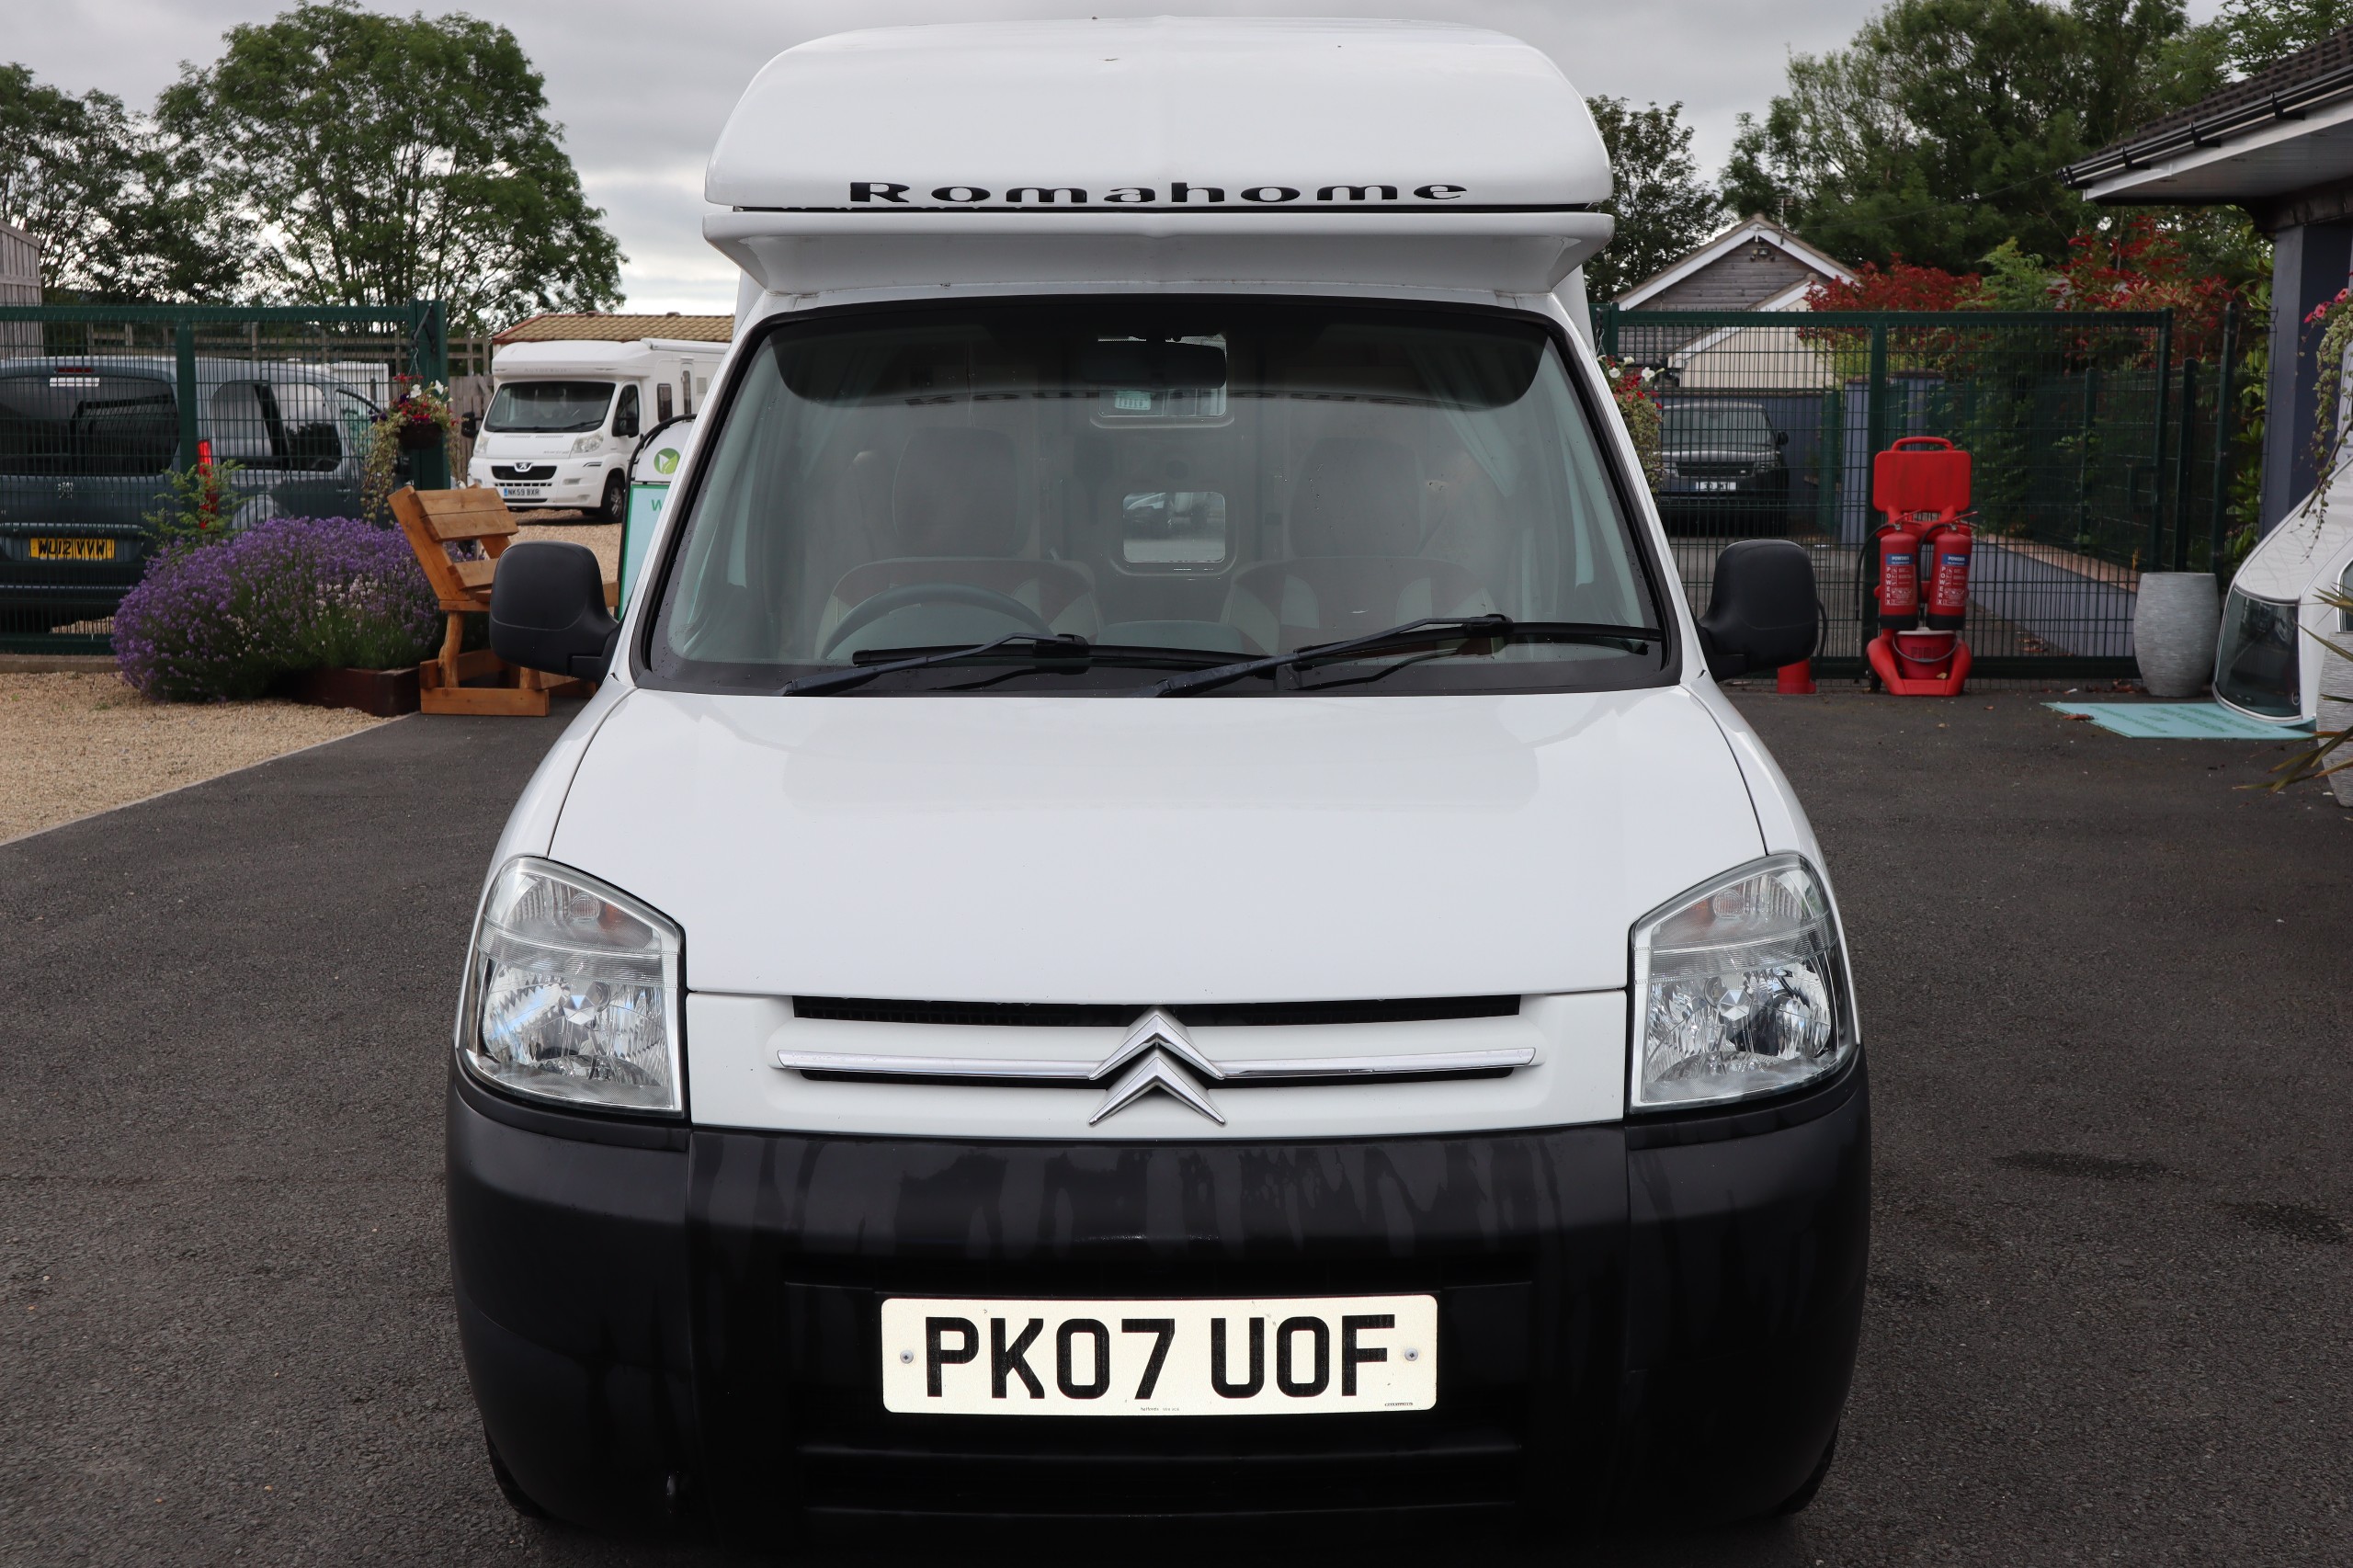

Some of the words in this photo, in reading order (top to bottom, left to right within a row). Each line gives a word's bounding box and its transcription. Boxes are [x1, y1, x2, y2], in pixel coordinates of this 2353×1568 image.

[849, 182, 1468, 204] Romahome
[925, 1317, 1176, 1400] PK07
[1211, 1314, 1395, 1399] UOF
